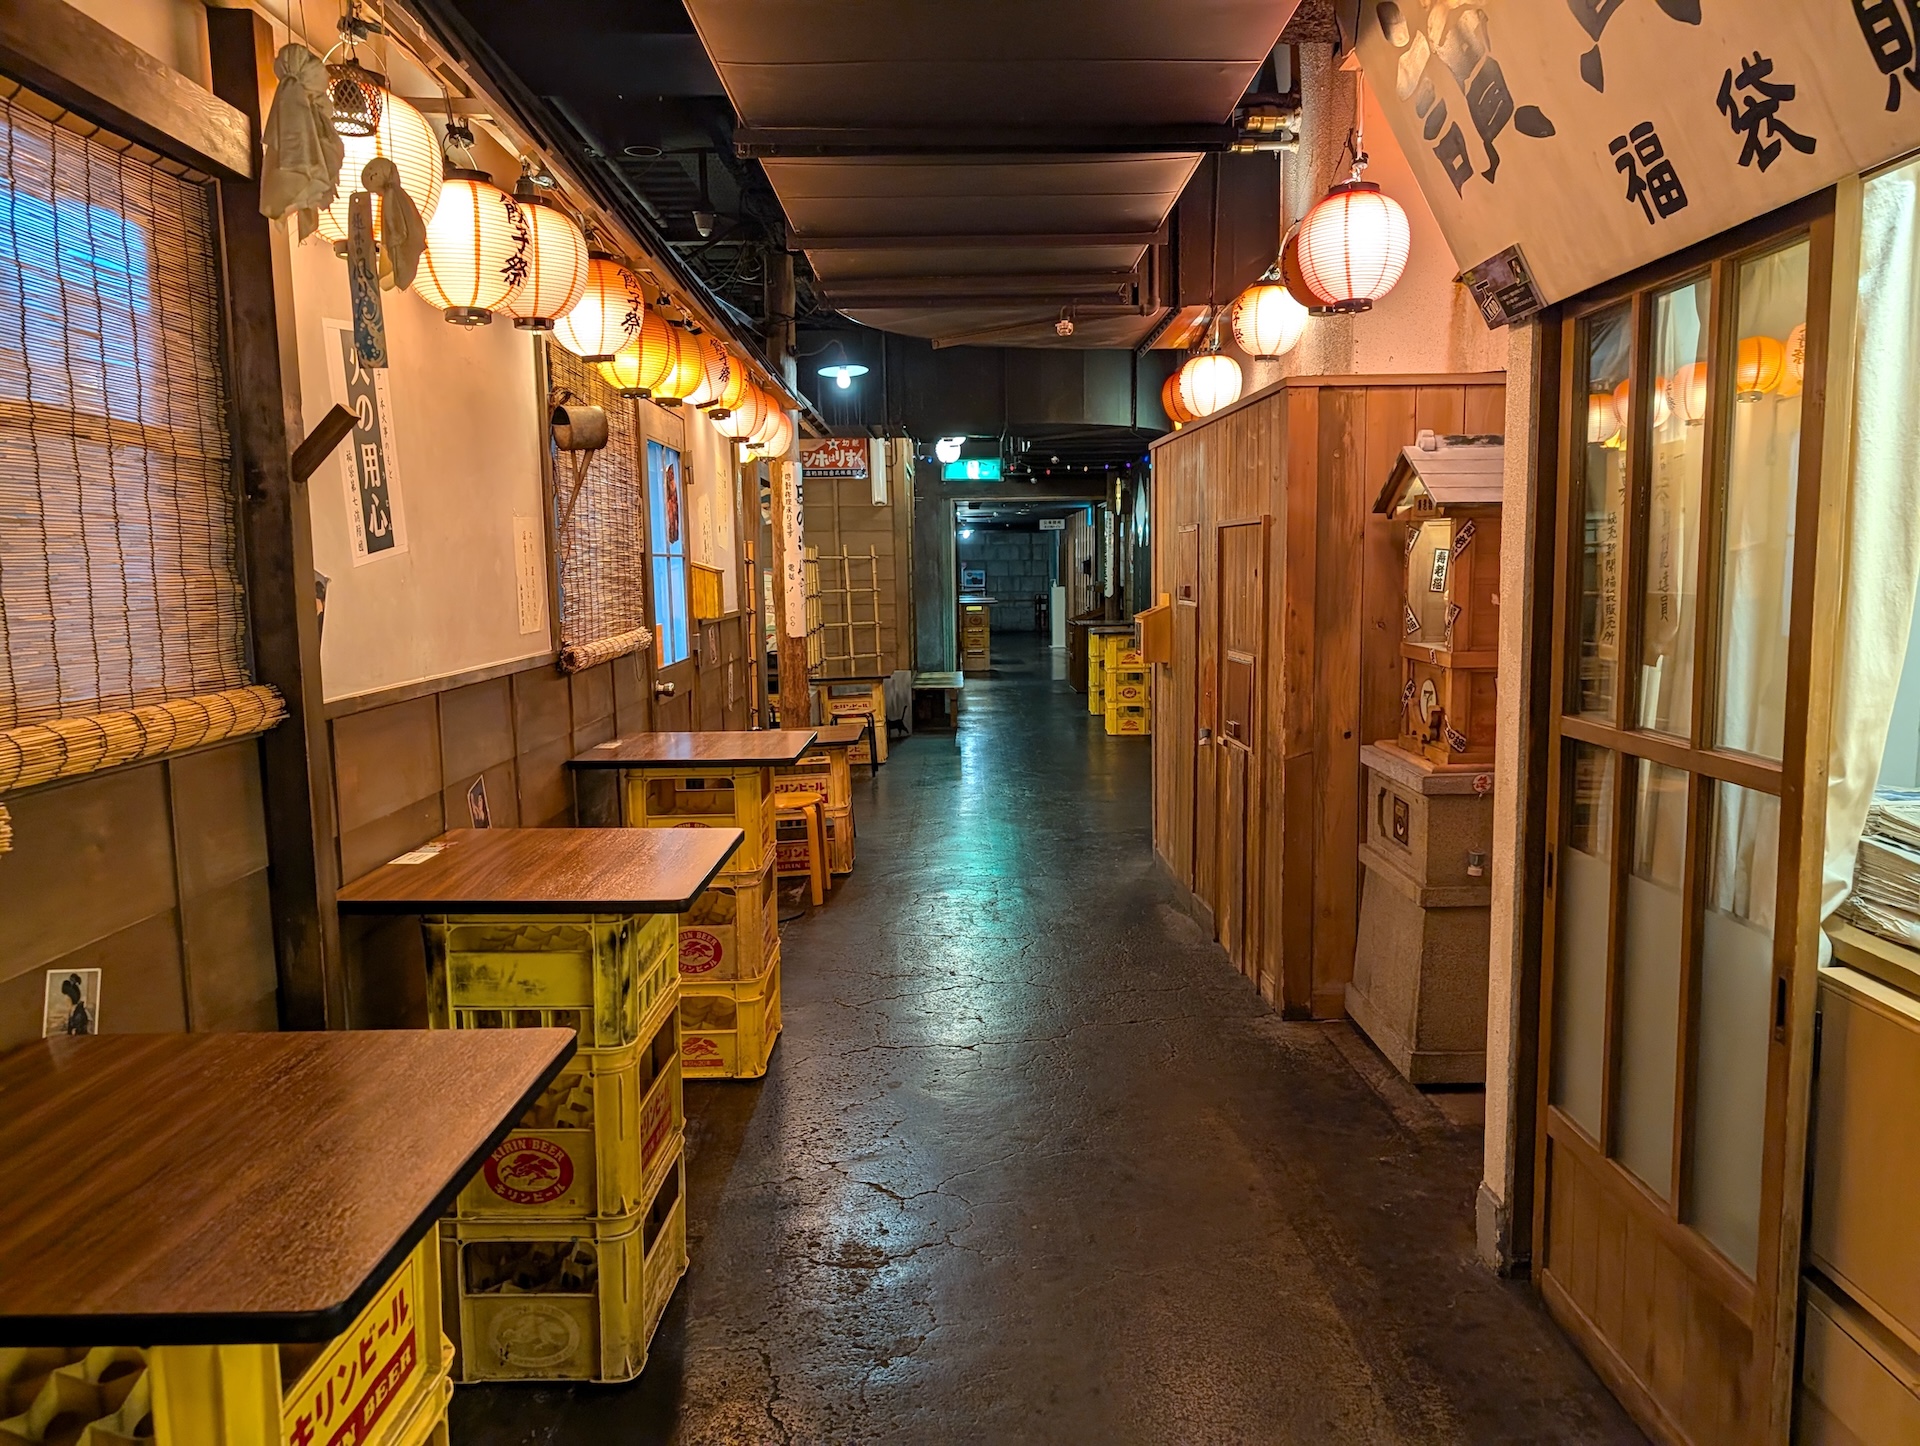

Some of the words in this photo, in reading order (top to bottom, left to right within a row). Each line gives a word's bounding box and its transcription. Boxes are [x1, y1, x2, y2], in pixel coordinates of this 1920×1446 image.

[617, 268, 641, 335] 餃子祭
[491, 1139, 528, 1162] KIRIN
[531, 1139, 565, 1162] BEER
[494, 1183, 567, 1203] キリンビール
